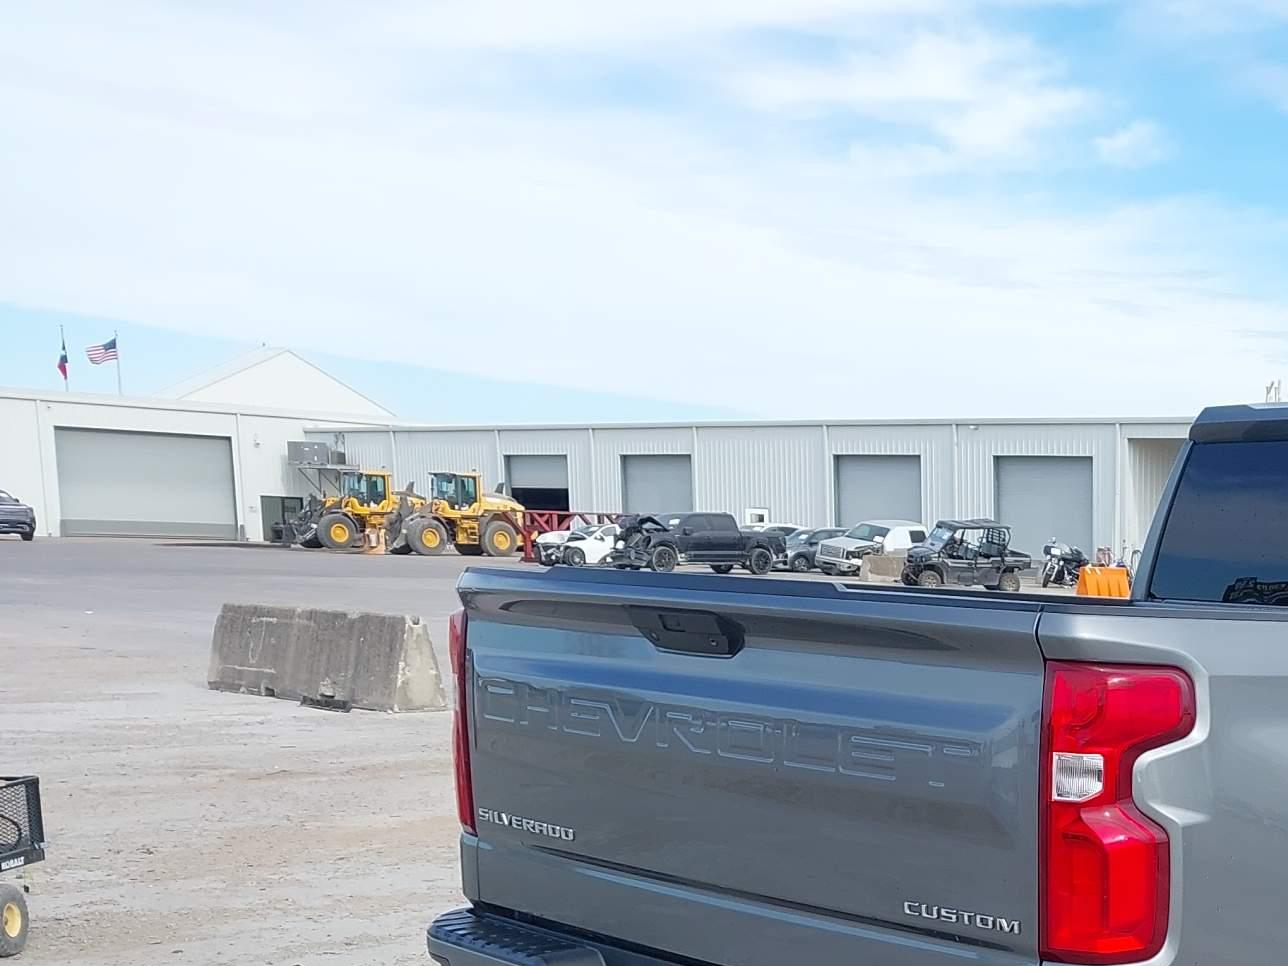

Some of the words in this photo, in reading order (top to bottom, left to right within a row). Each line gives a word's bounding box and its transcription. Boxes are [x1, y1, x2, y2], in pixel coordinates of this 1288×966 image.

[477, 679, 980, 788] CHEVROLET
[478, 807, 576, 842] SILVERADO
[903, 900, 1022, 935] CUSTOM
